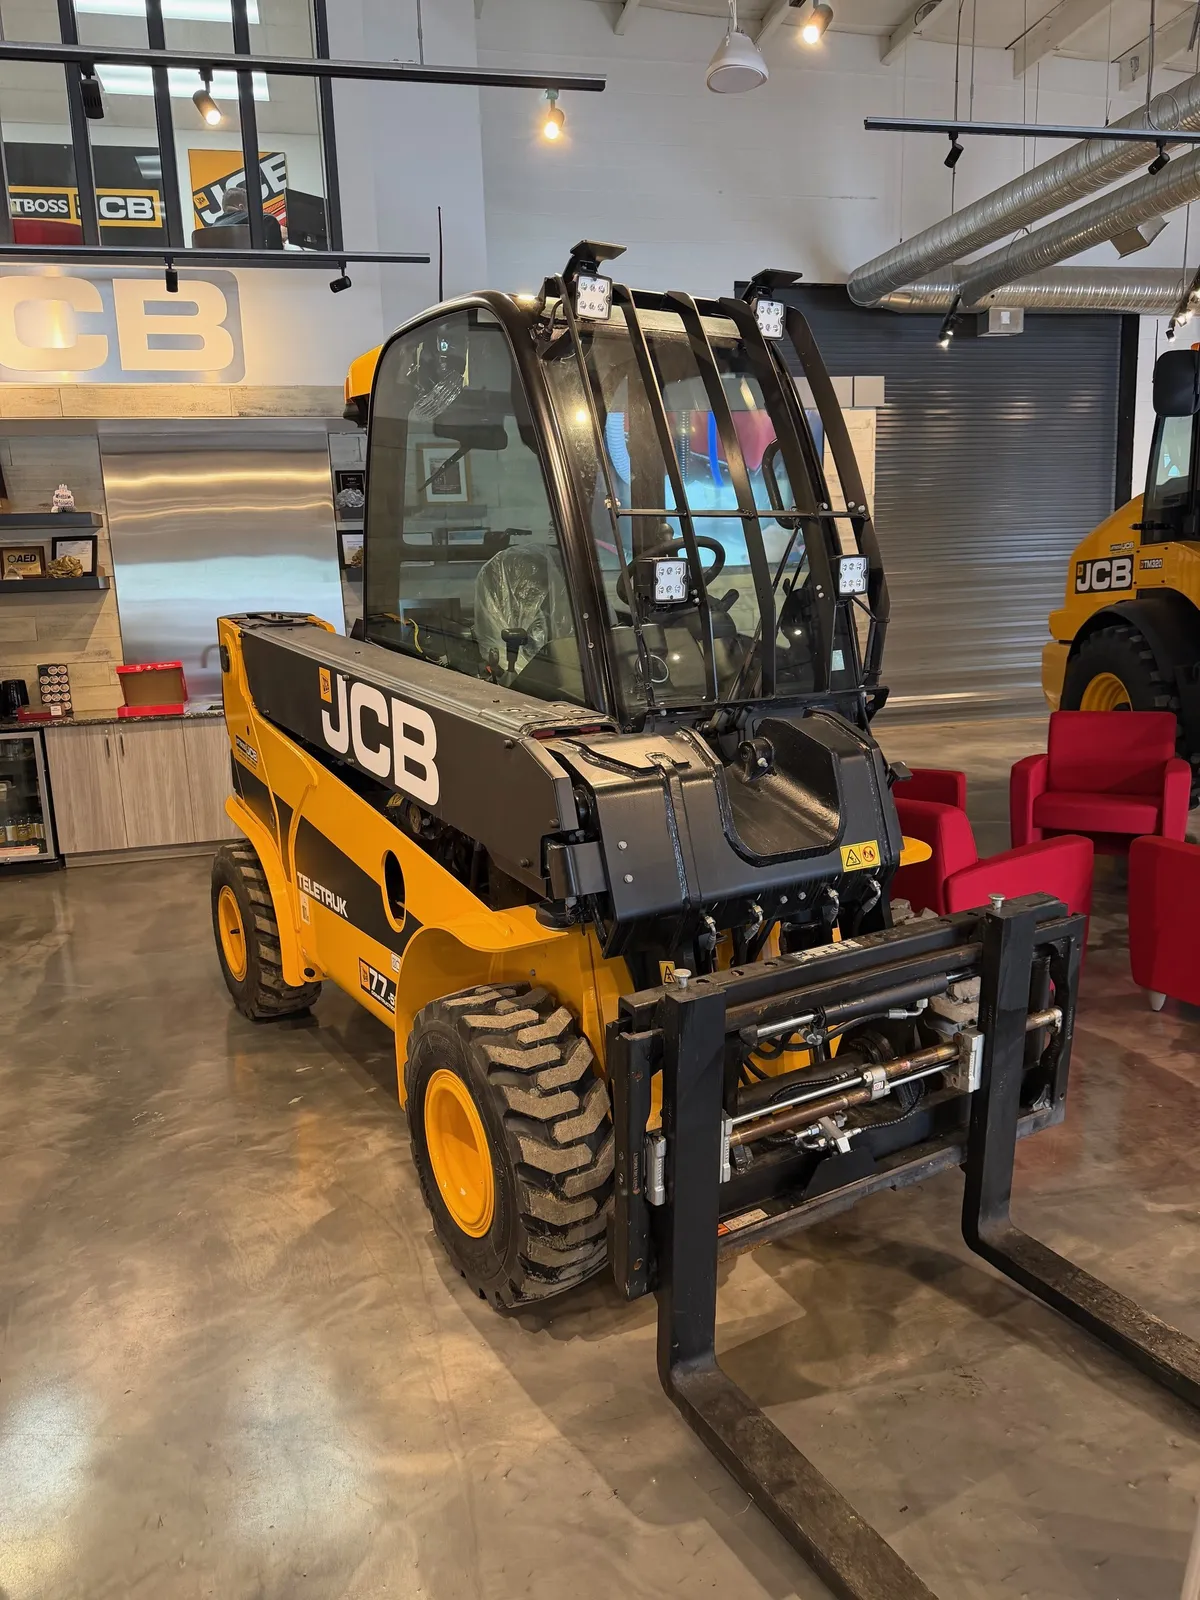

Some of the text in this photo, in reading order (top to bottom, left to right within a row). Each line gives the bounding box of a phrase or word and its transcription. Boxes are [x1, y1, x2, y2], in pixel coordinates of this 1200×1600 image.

[76, 196, 154, 219] CB
[1076, 558, 1132, 592] JCB
[1143, 559, 1163, 569] TM320
[321, 673, 440, 806] JCB
[297, 871, 349, 919] TELETRUK
